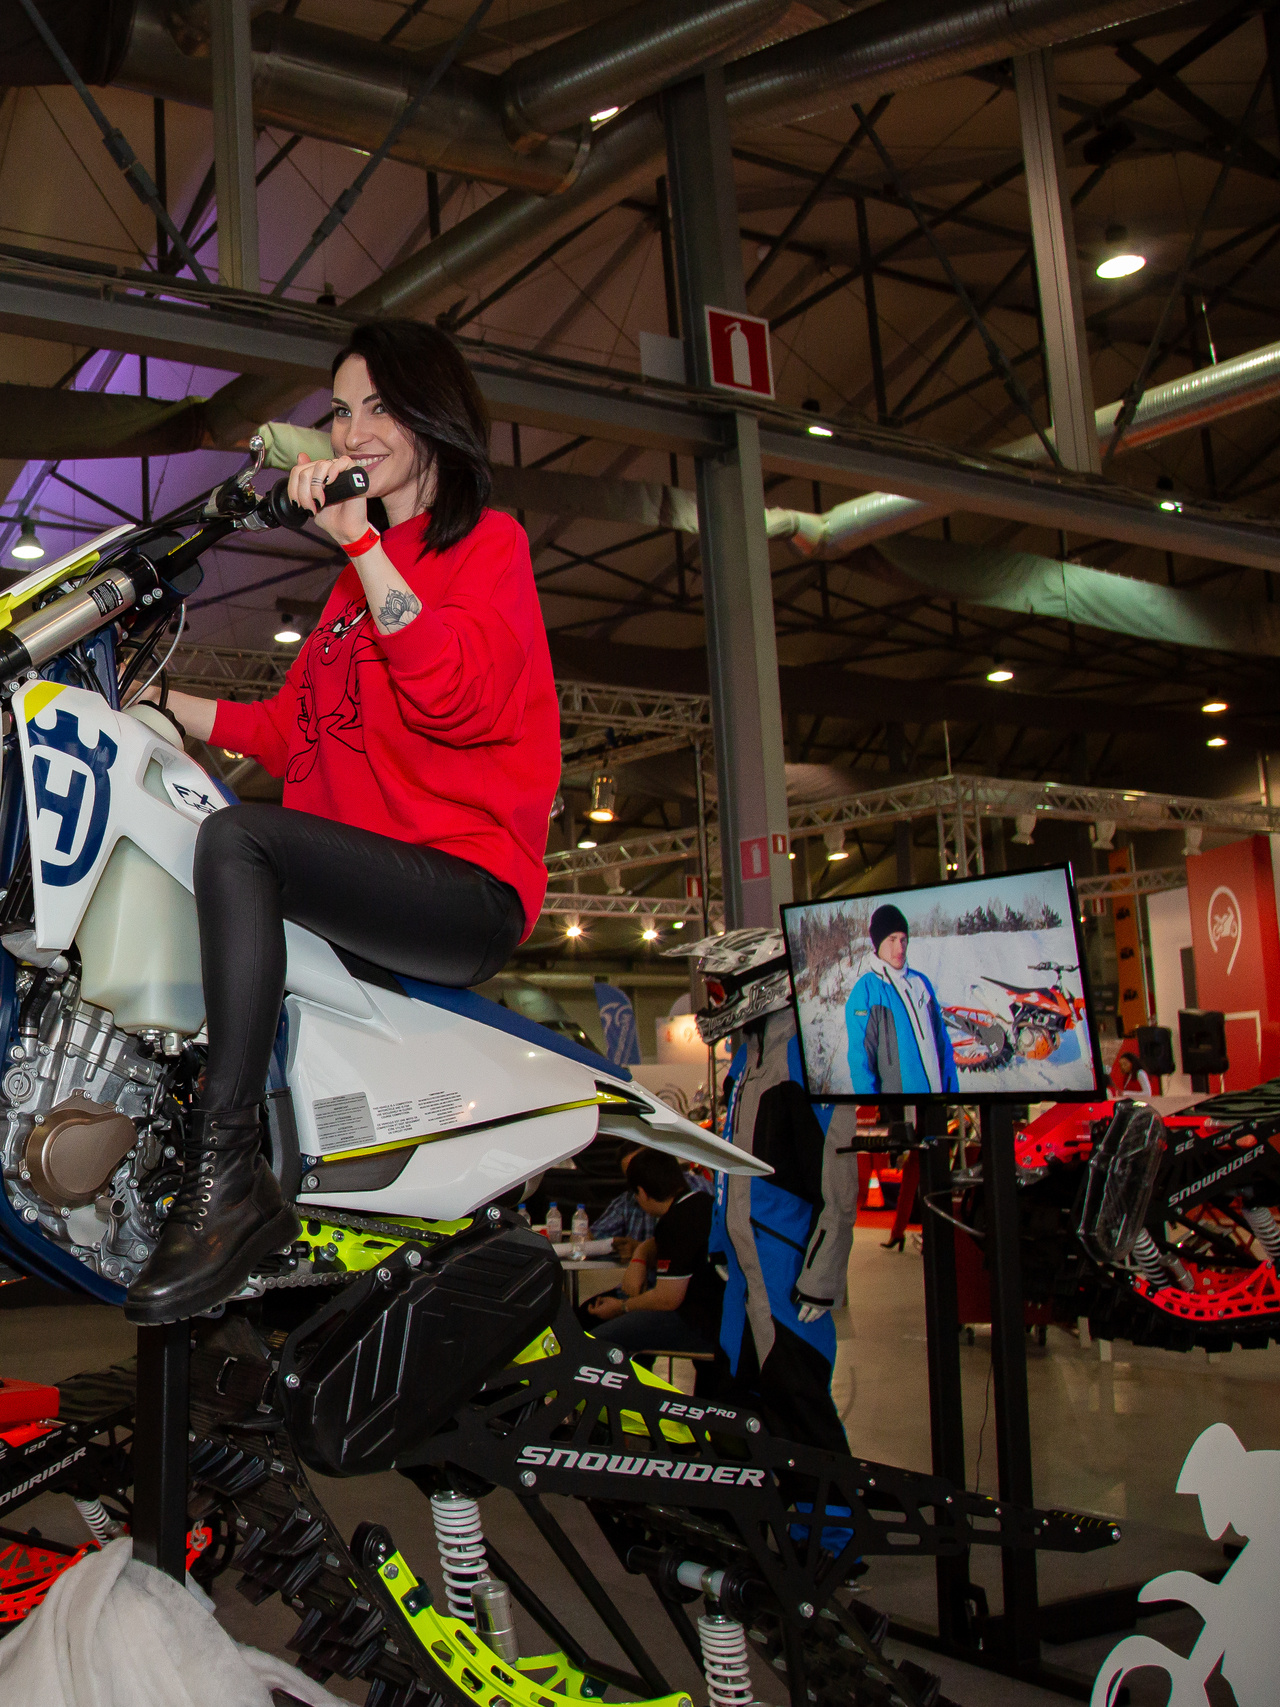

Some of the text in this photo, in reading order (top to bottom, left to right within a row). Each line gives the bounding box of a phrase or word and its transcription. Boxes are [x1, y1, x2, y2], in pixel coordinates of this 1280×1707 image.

[172, 783, 219, 811] FX
[1174, 1138, 1195, 1156] SE
[1167, 1144, 1265, 1208] SNOWRIDER
[574, 1365, 630, 1390] SE
[516, 1445, 766, 1487] SNOWRIDER
